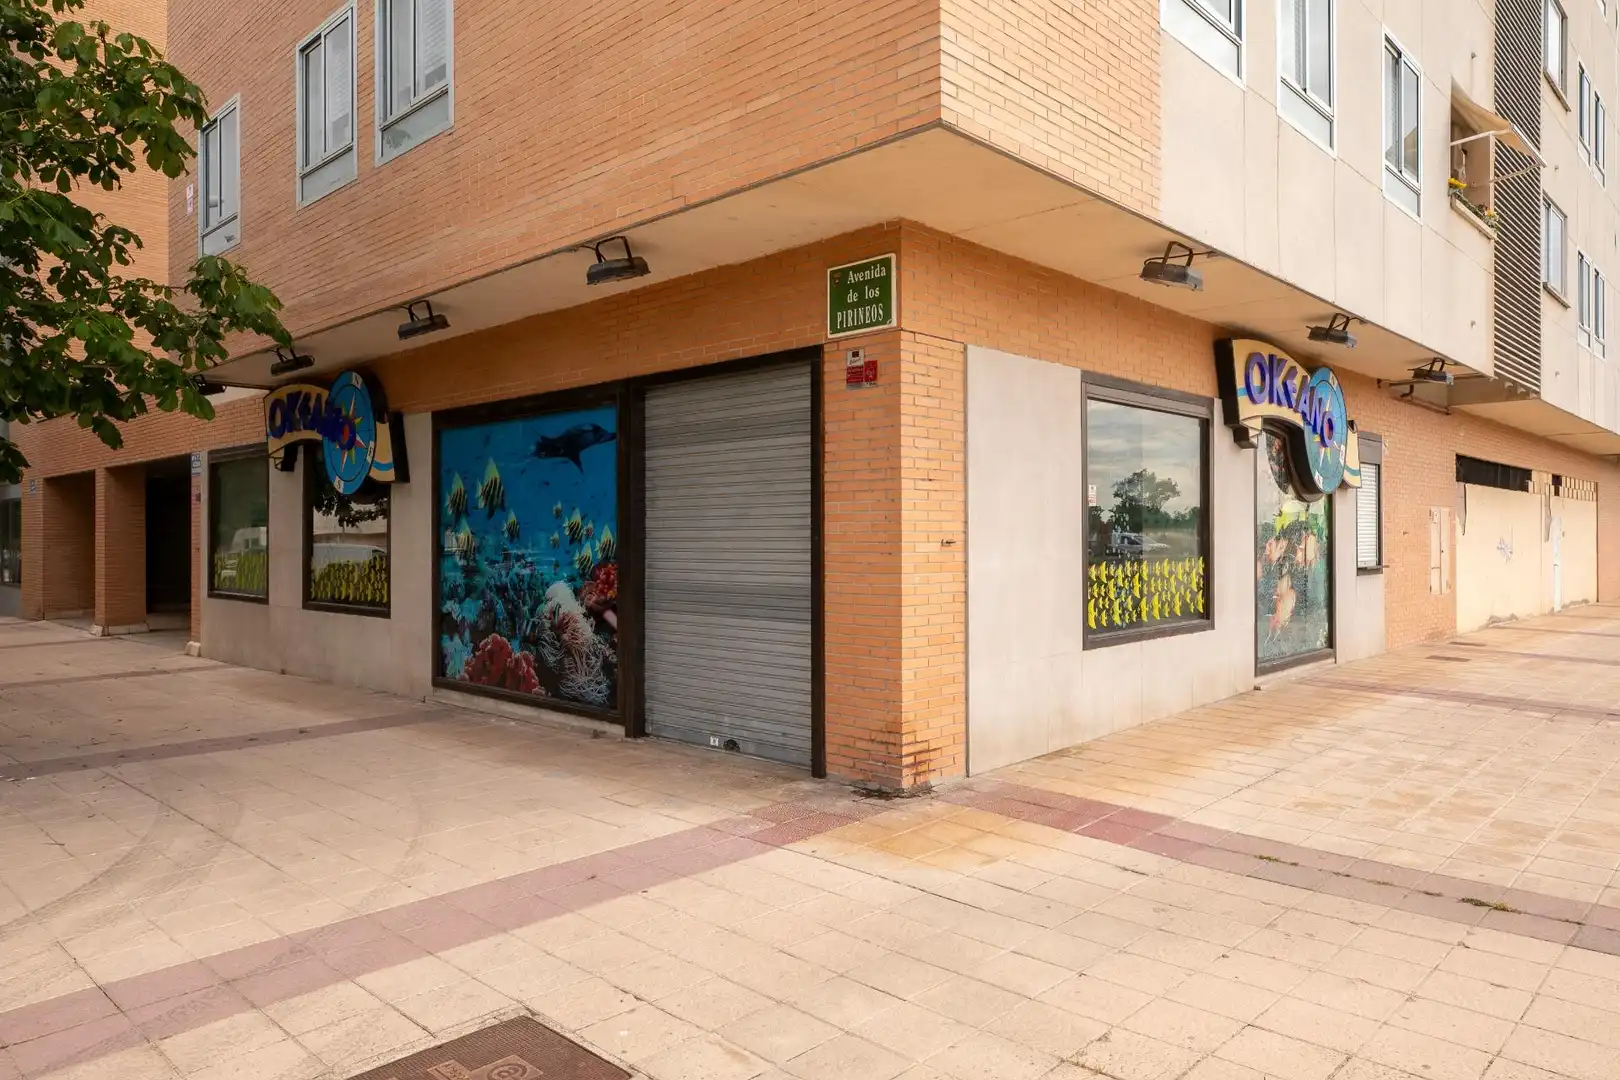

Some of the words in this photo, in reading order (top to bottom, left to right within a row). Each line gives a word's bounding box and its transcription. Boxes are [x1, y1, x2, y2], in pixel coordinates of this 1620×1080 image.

[847, 263, 887, 284] Avenida
[847, 289, 859, 303] de
[865, 285, 880, 299] los
[837, 303, 884, 329] PIRINEOS
[1244, 352, 1335, 448] OKEANO
[268, 390, 356, 451] OKEANO
